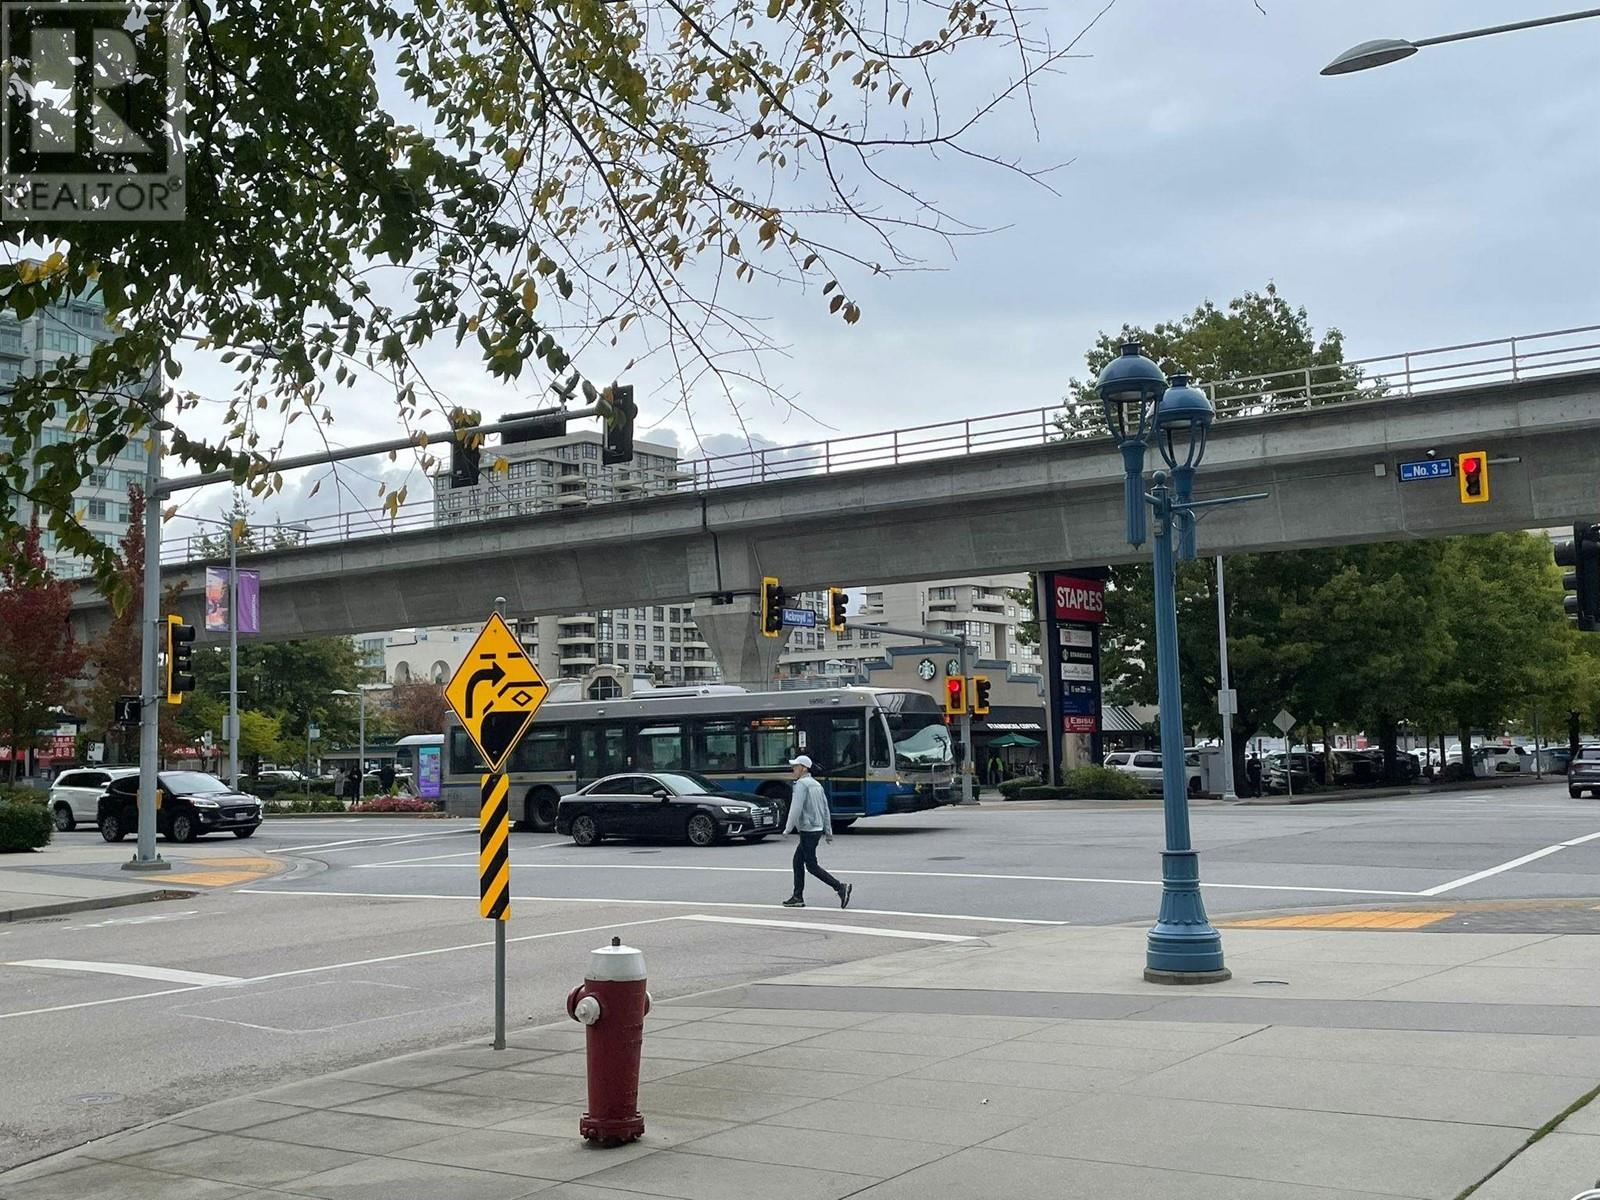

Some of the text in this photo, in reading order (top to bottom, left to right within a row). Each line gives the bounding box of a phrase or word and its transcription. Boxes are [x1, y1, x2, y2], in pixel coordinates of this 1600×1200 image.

[1413, 465, 1429, 476] No.
[1431, 463, 1438, 474] 3
[1057, 586, 1103, 612] STAPLES
